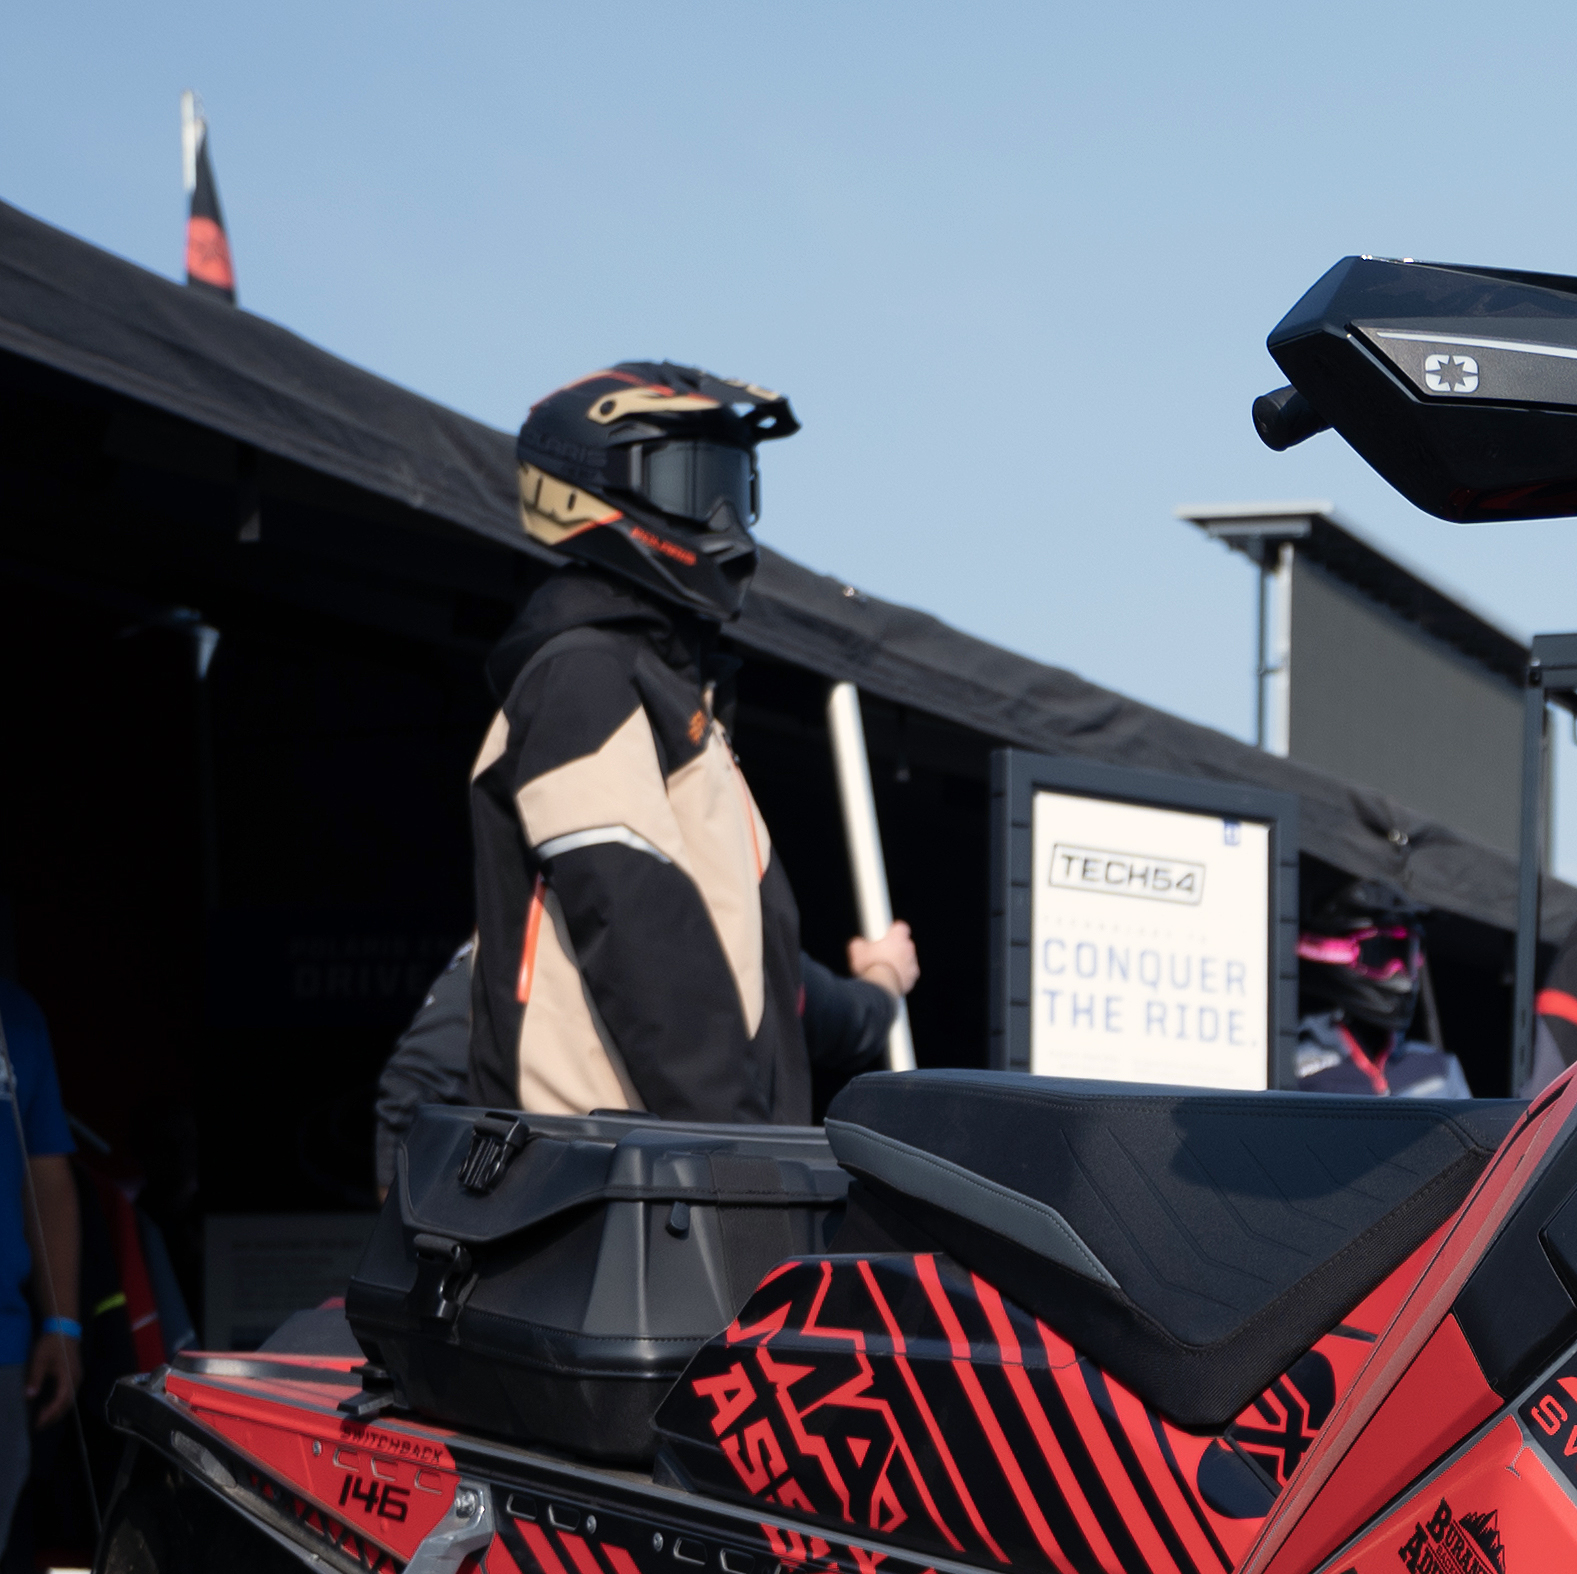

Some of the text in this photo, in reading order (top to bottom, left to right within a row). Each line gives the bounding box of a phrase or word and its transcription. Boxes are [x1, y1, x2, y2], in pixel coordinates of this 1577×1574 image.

[1062, 854, 1196, 894] TECH54
[1043, 938, 1246, 997] CONQUER
[1042, 989, 1257, 1047] THE RIDE.
[341, 1423, 443, 1464] SWITCHBACK
[338, 1473, 410, 1523] 146
